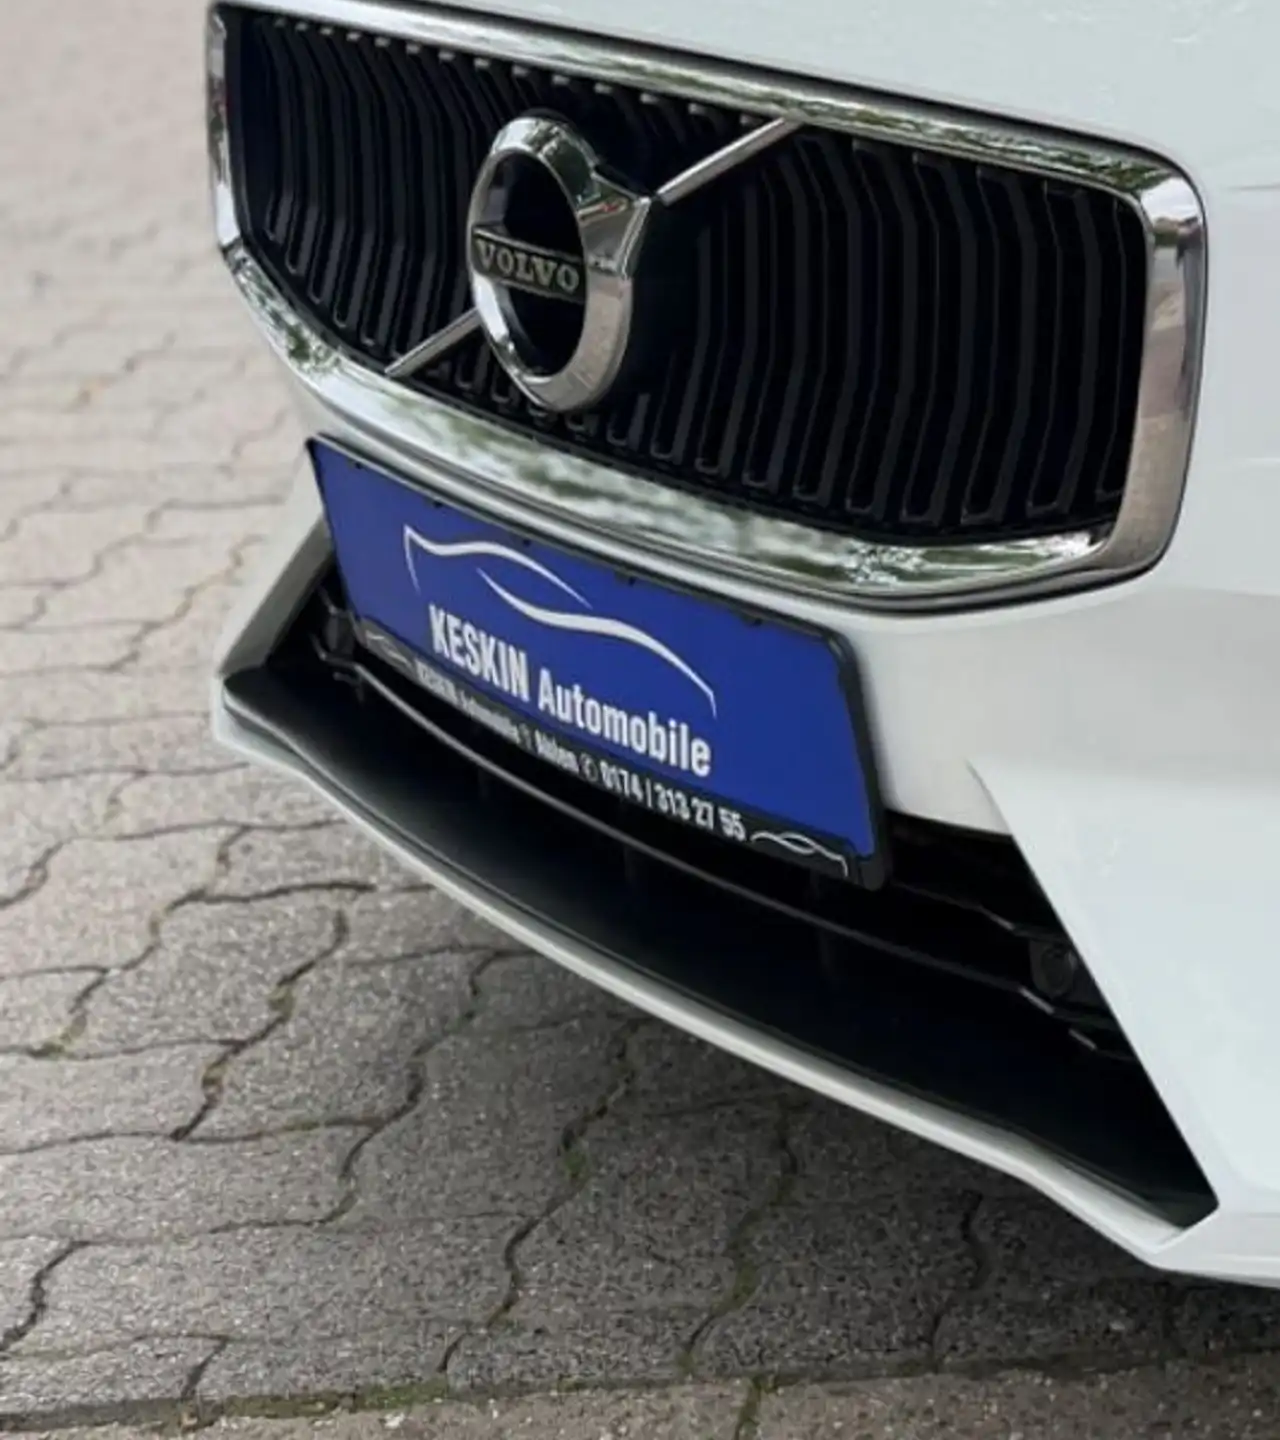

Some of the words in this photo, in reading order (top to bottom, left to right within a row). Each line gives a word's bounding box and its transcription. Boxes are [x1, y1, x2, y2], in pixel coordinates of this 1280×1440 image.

[475, 237, 580, 294] VOLVO
[428, 602, 531, 703] KESKIN
[536, 666, 712, 778] Automobile
